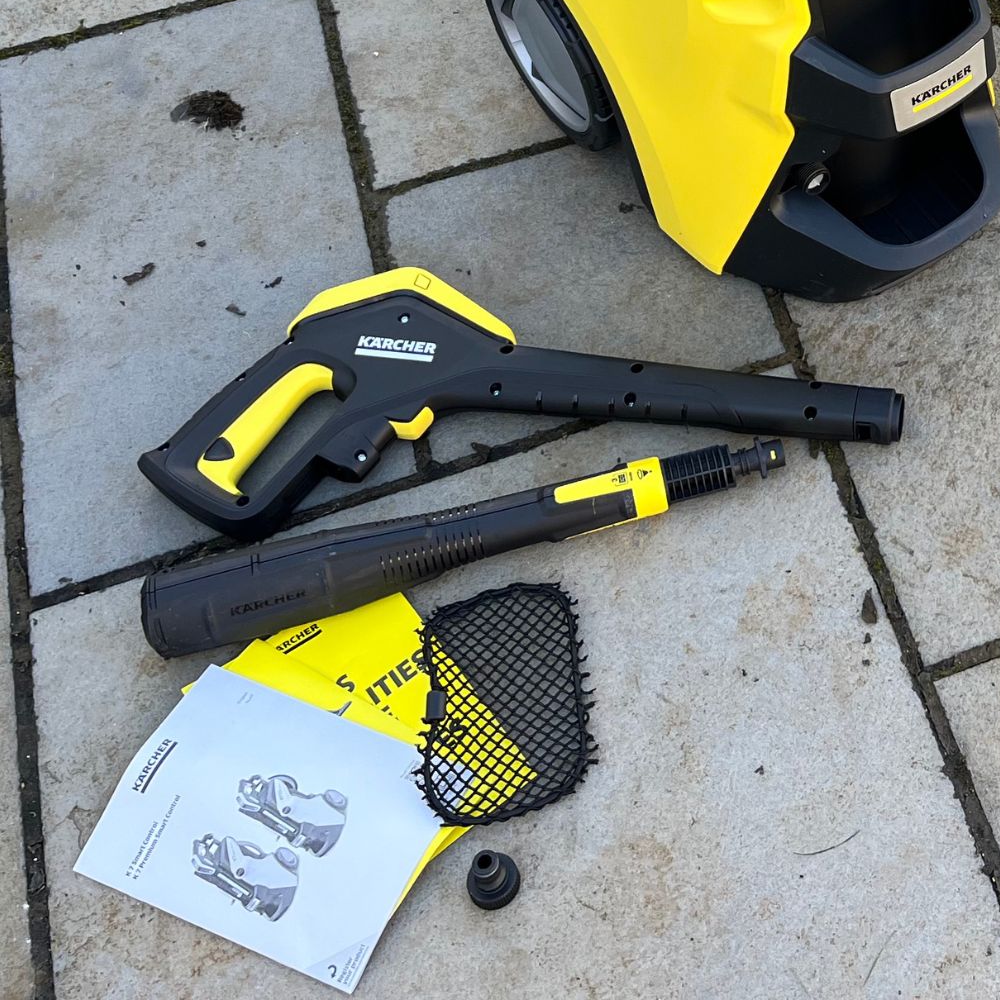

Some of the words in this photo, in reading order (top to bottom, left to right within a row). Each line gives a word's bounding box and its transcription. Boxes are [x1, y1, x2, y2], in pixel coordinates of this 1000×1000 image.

[911, 64, 971, 106] KÄRCHER
[357, 335, 437, 354] KÄRCHER
[335, 673, 356, 693] S
[365, 648, 428, 705] ITIES
[131, 738, 172, 792] KÄRCHER
[131, 844, 146, 866] Smart
[142, 821, 159, 845] Control
[139, 837, 159, 869] Premium
[155, 818, 169, 839] Smart
[165, 794, 181, 818] Control
